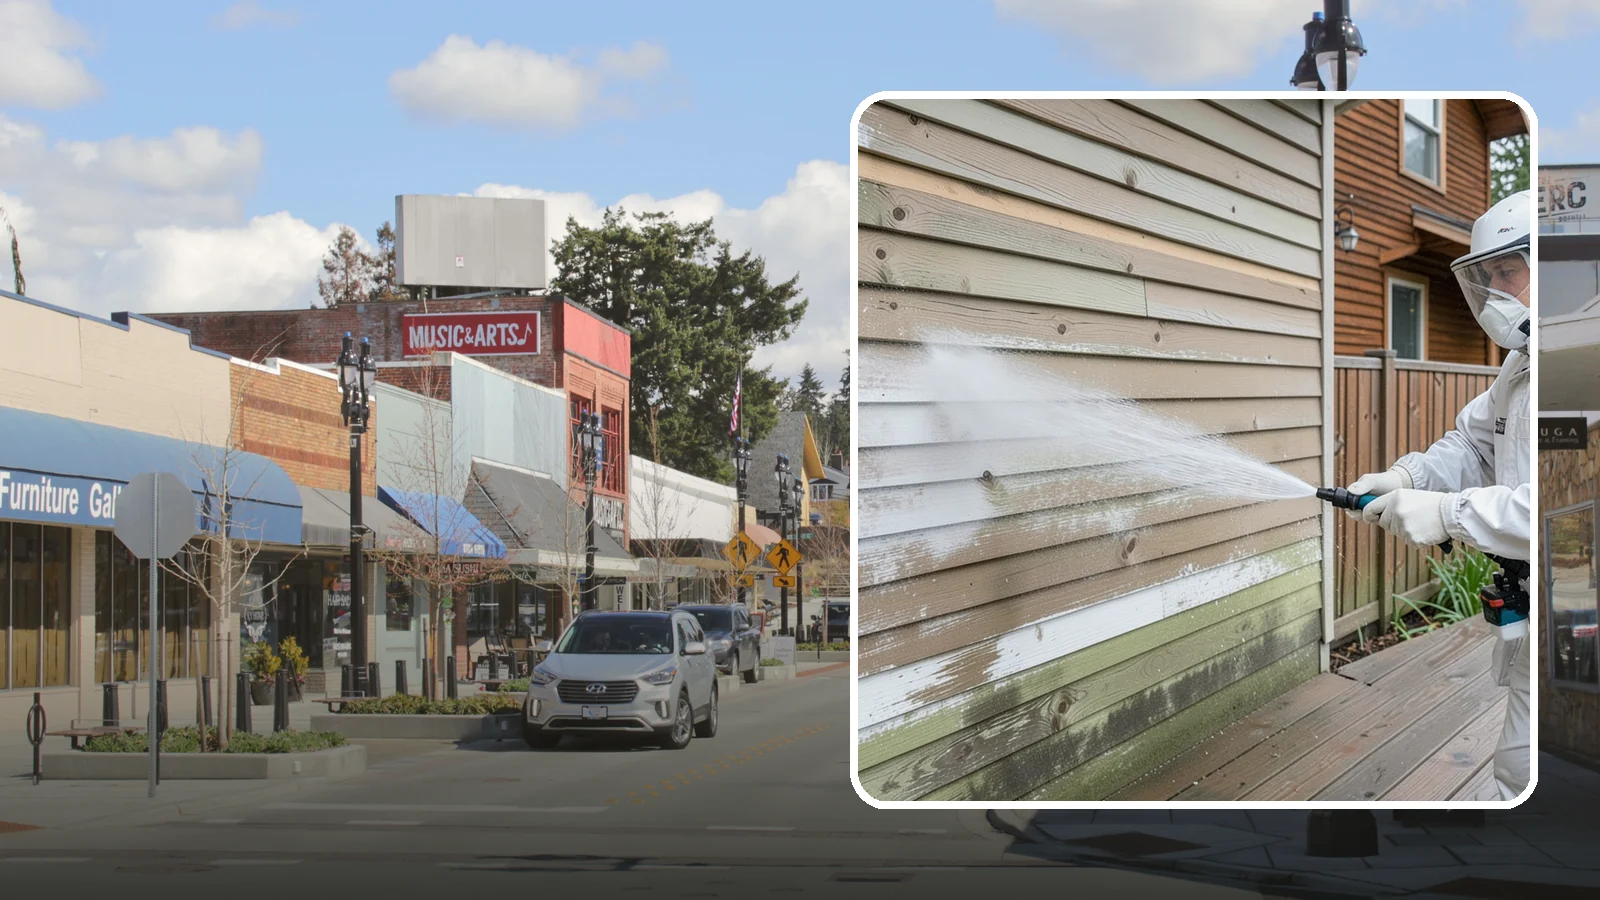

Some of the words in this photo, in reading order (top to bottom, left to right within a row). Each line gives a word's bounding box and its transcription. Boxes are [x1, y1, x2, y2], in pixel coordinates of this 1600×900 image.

[1540, 427, 1577, 436] UGA
[0, 471, 79, 515] Furniture
[453, 563, 479, 574] SUSHI
